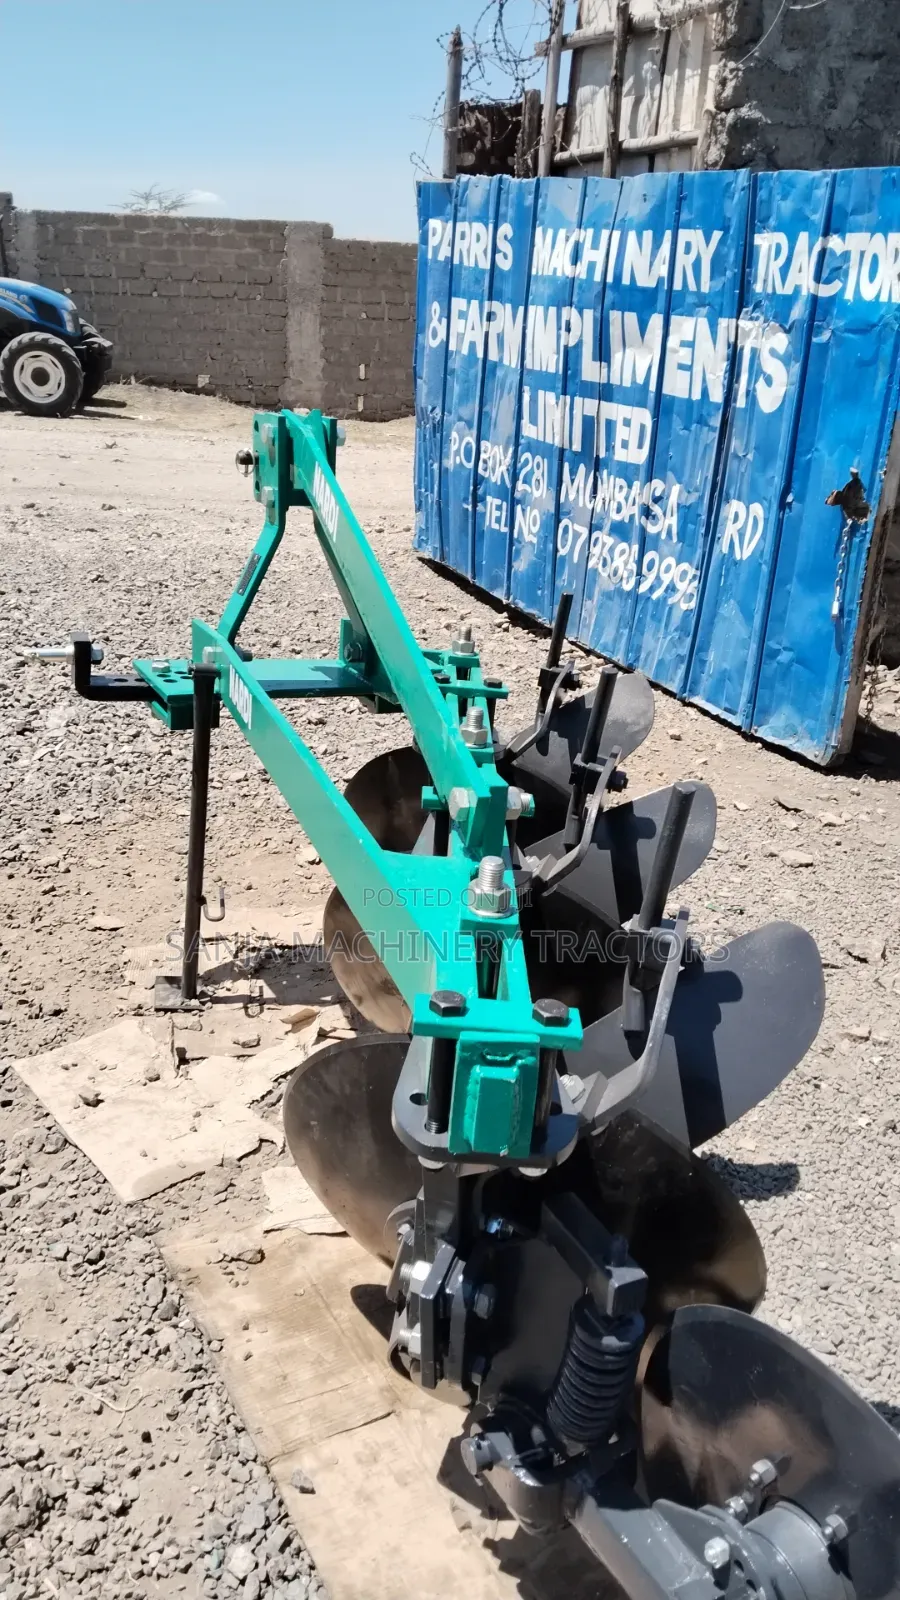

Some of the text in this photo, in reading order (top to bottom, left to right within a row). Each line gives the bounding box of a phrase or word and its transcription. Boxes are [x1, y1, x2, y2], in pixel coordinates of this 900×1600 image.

[427, 218, 513, 271] PARRIS
[531, 226, 724, 293] MACHINARY
[428, 301, 446, 348] &
[521, 385, 652, 465] LIMITED
[478, 440, 513, 489] BOX
[516, 451, 548, 499] 281
[722, 500, 764, 561] RD
[485, 495, 509, 533] TEL
